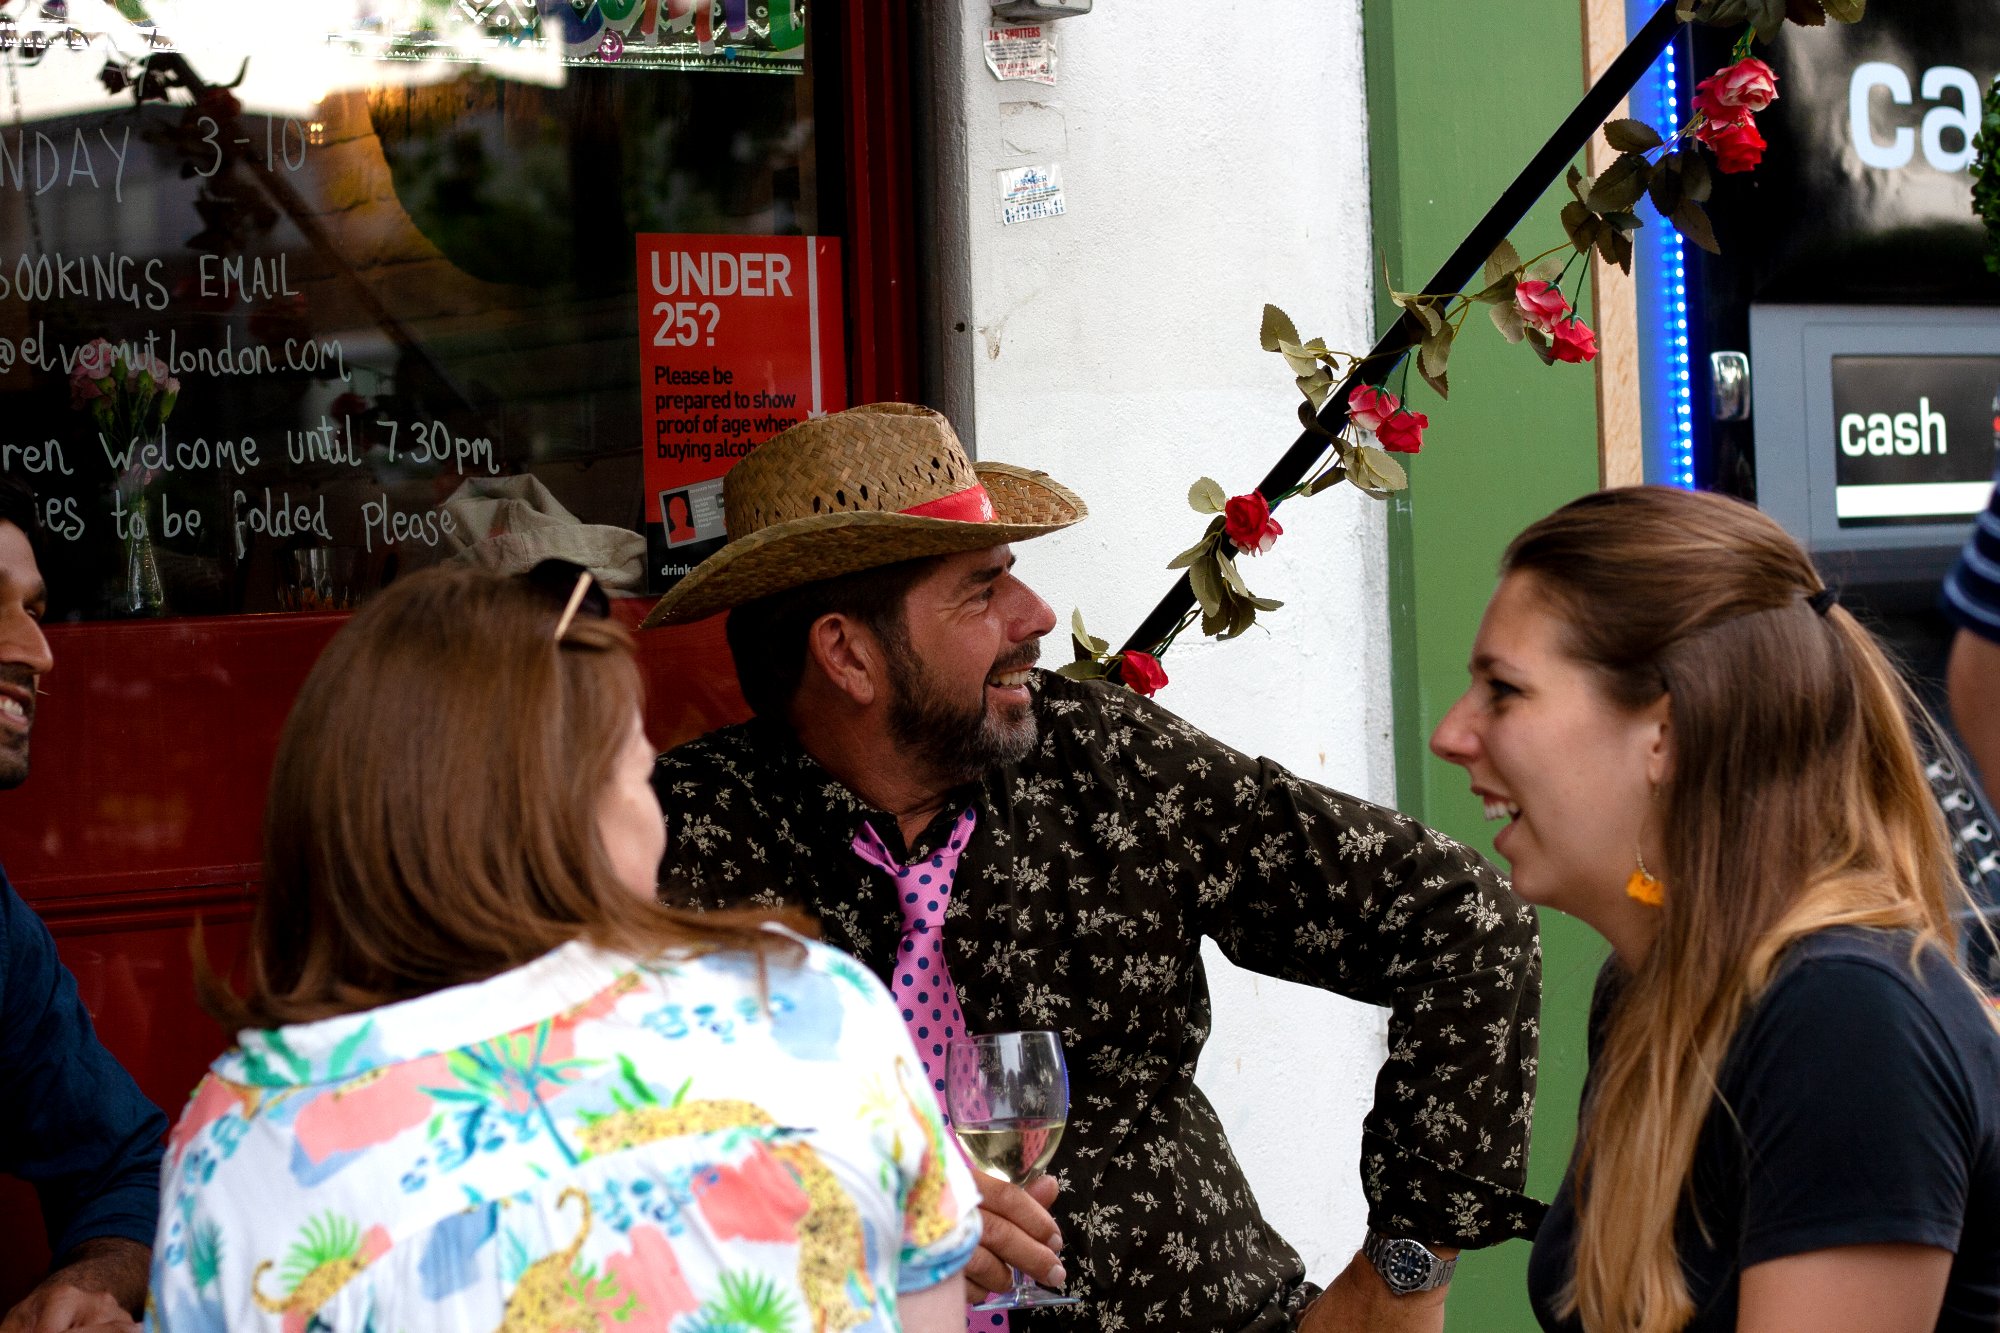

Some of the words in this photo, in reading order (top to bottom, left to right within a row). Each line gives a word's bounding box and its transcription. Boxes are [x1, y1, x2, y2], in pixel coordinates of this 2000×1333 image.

[1849, 61, 2000, 173] ca
[200, 252, 300, 303] EMAIL
[651, 251, 793, 297] UNDER
[653, 302, 721, 347] 25?
[655, 365, 710, 385] Please
[713, 366, 733, 385] be
[656, 390, 731, 414] prepared
[734, 390, 750, 409] to
[753, 389, 797, 409] show
[287, 415, 362, 467] until
[377, 420, 500, 474] 7.30pm
[657, 414, 699, 440] proof
[703, 413, 719, 433] of
[721, 418, 751, 438] age
[752, 413, 798, 432] when
[1840, 397, 1947, 457] cash
[657, 438, 711, 463] buying
[111, 490, 146, 541] to
[163, 493, 201, 539] be
[233, 487, 333, 560] folded
